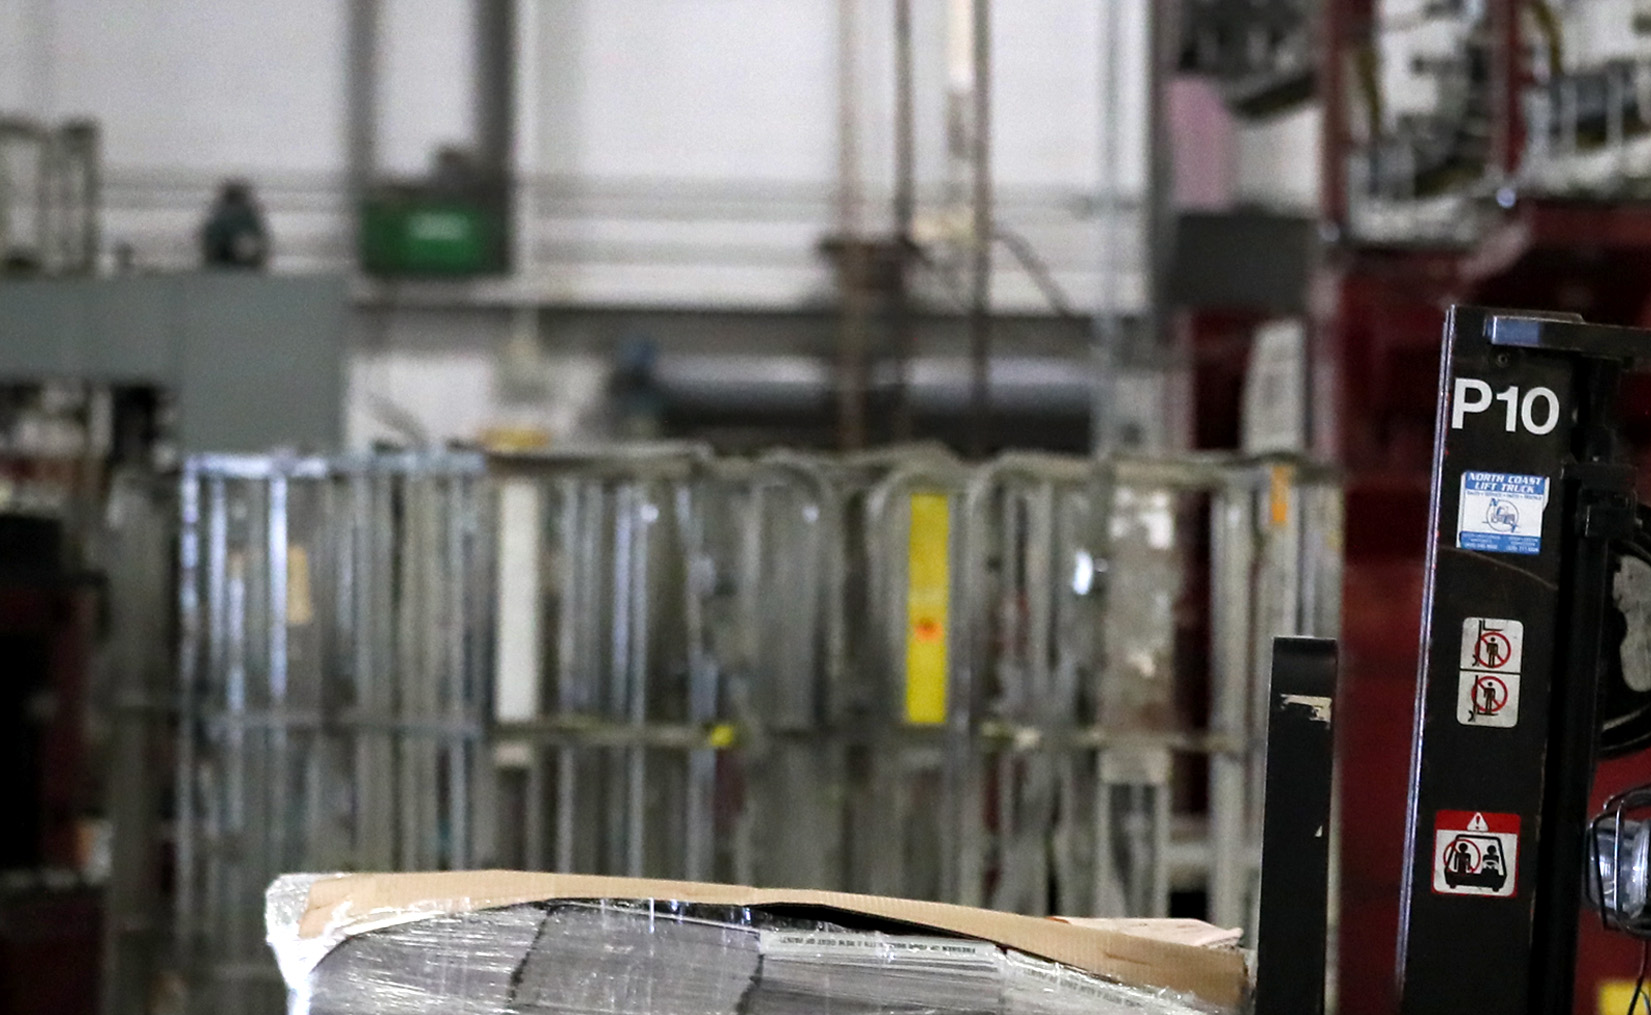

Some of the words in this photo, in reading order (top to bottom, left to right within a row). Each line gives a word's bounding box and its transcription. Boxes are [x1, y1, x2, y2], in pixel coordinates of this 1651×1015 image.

[1451, 377, 1560, 436] P10
[1469, 472, 1504, 482] NORTH
[1508, 476, 1542, 486] COAST
[1474, 482, 1498, 491] LIFT
[1501, 484, 1535, 493] TRUCK
